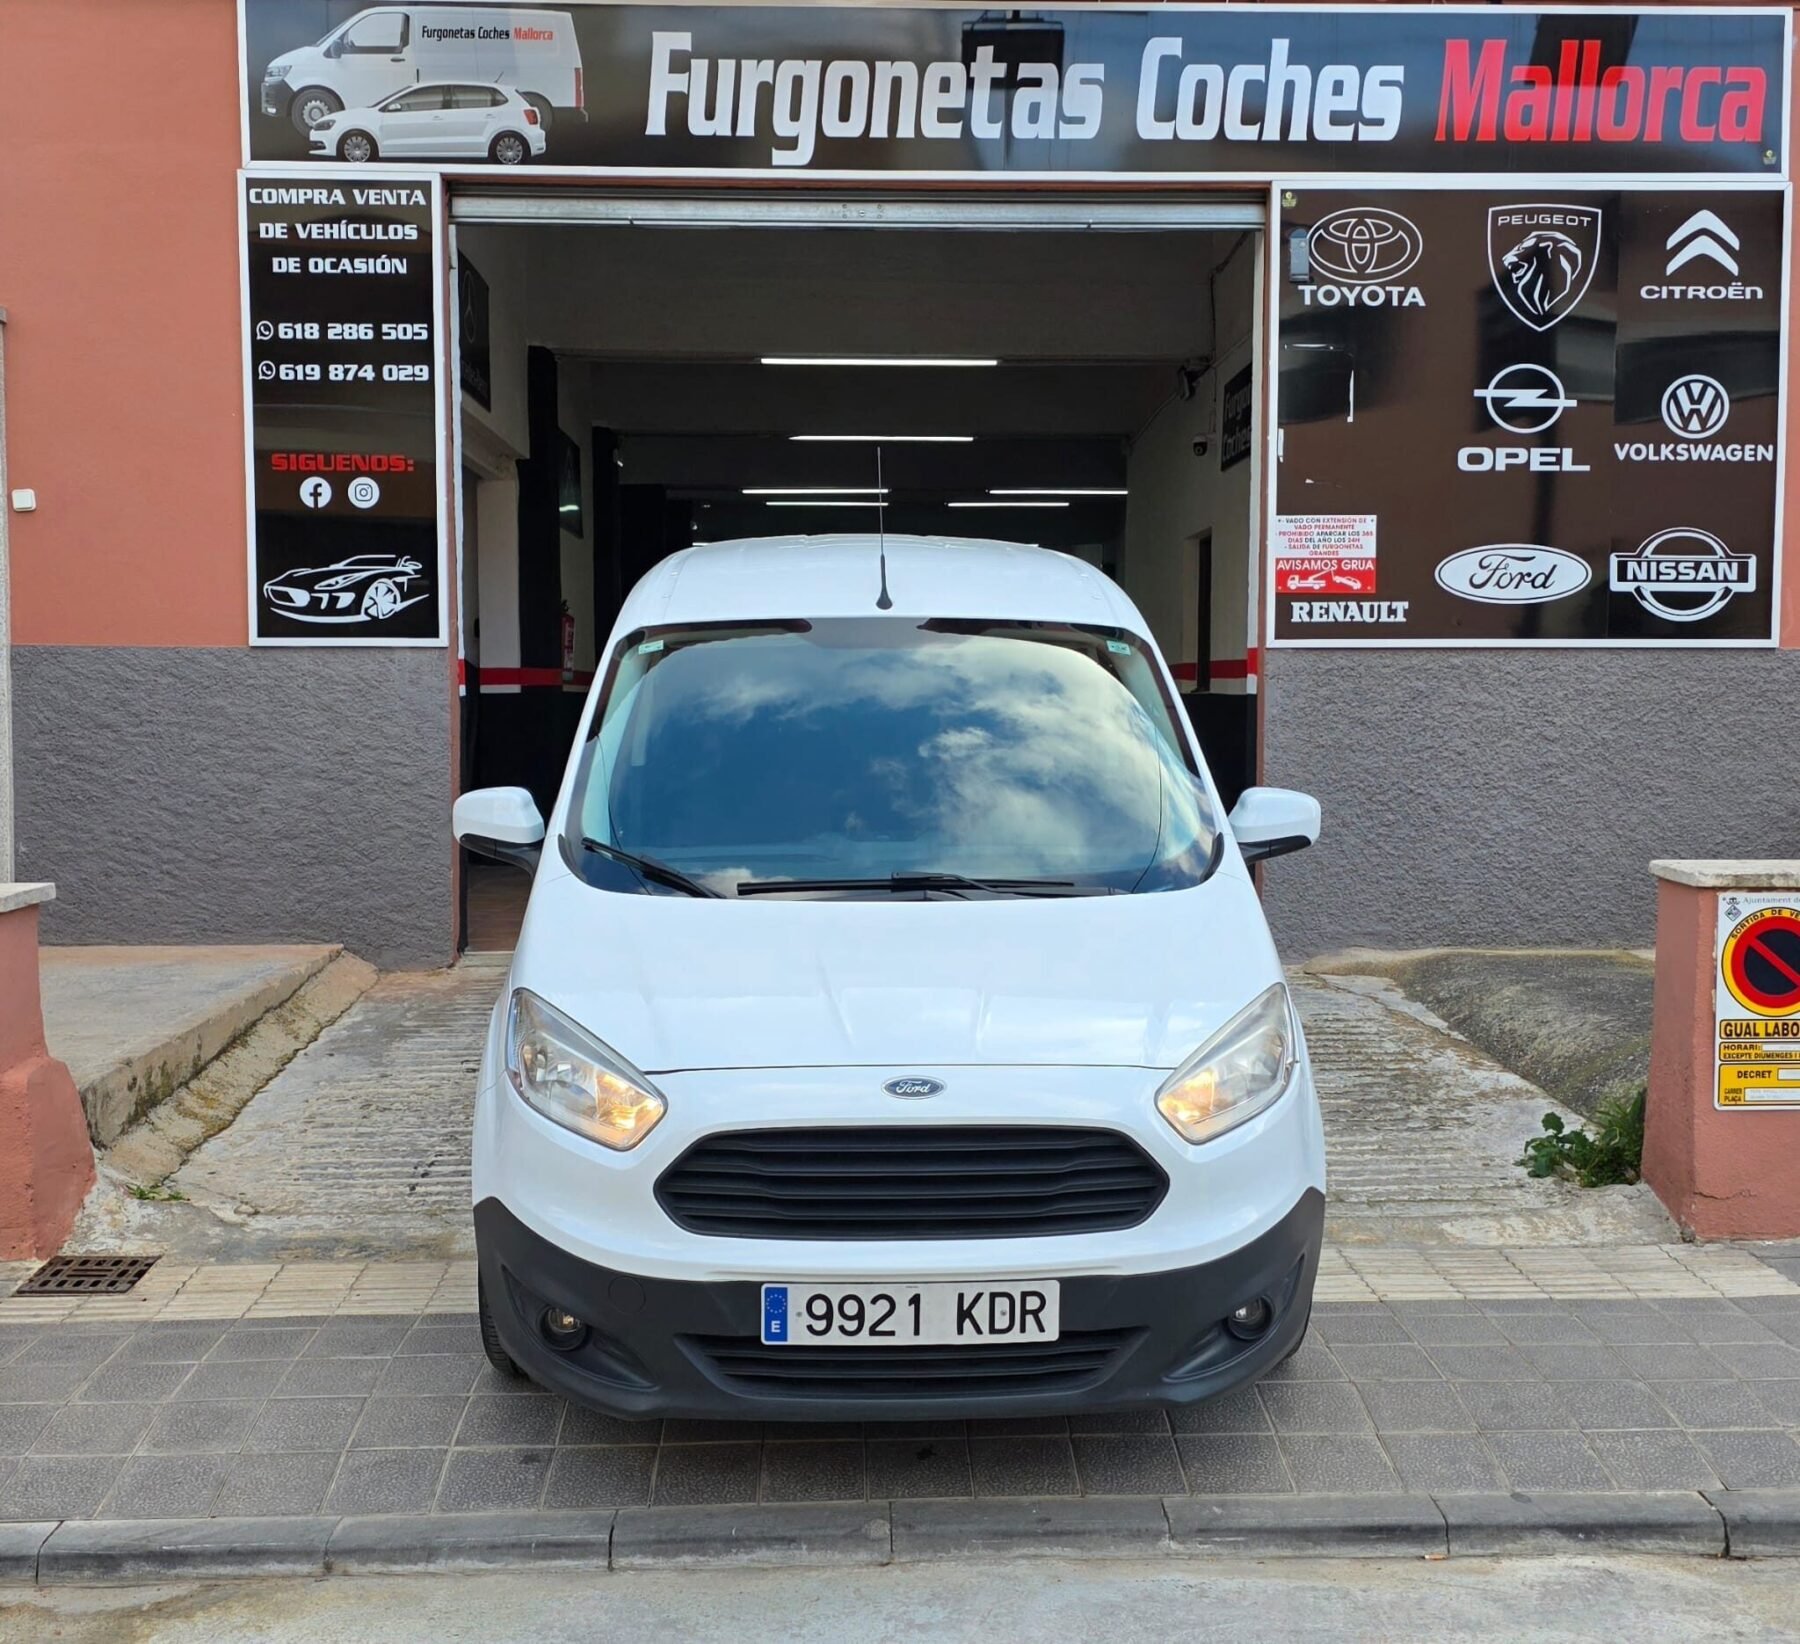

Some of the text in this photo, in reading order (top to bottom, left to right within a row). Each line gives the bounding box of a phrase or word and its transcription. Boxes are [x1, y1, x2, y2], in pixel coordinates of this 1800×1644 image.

[422, 25, 553, 41] Furgonetas Coches Mallorca
[645, 31, 1767, 166] Furgonetas Coches Mallorca
[249, 188, 426, 206] COMPRA VENTA
[259, 220, 418, 240] DE VEHÍCULOS
[1497, 213, 1592, 228] PEUGEOT
[272, 255, 407, 274] DE OCASIÓN
[1298, 284, 1426, 307] TOYOTA
[278, 323, 428, 340] 618 286 505
[279, 364, 429, 381] 619 874 029
[1457, 447, 1591, 472] OPEL
[1614, 443, 1774, 462] VOLKSWAGEN
[271, 453, 414, 472] SIGUENOS:
[1276, 559, 1375, 571] AVISAMOS GRUA
[1469, 553, 1558, 590] Ford
[1626, 561, 1739, 582] NISSAN
[1290, 601, 1409, 622] RENAULT
[1743, 897, 1791, 906] Ajuntament
[1731, 912, 1766, 939] SORTIDA
[1724, 1022, 1760, 1037] GUAL
[1737, 1071, 1773, 1079] DECRET
[896, 1080, 932, 1093] Ford
[770, 1291, 1047, 1337] E 9921 KDR
